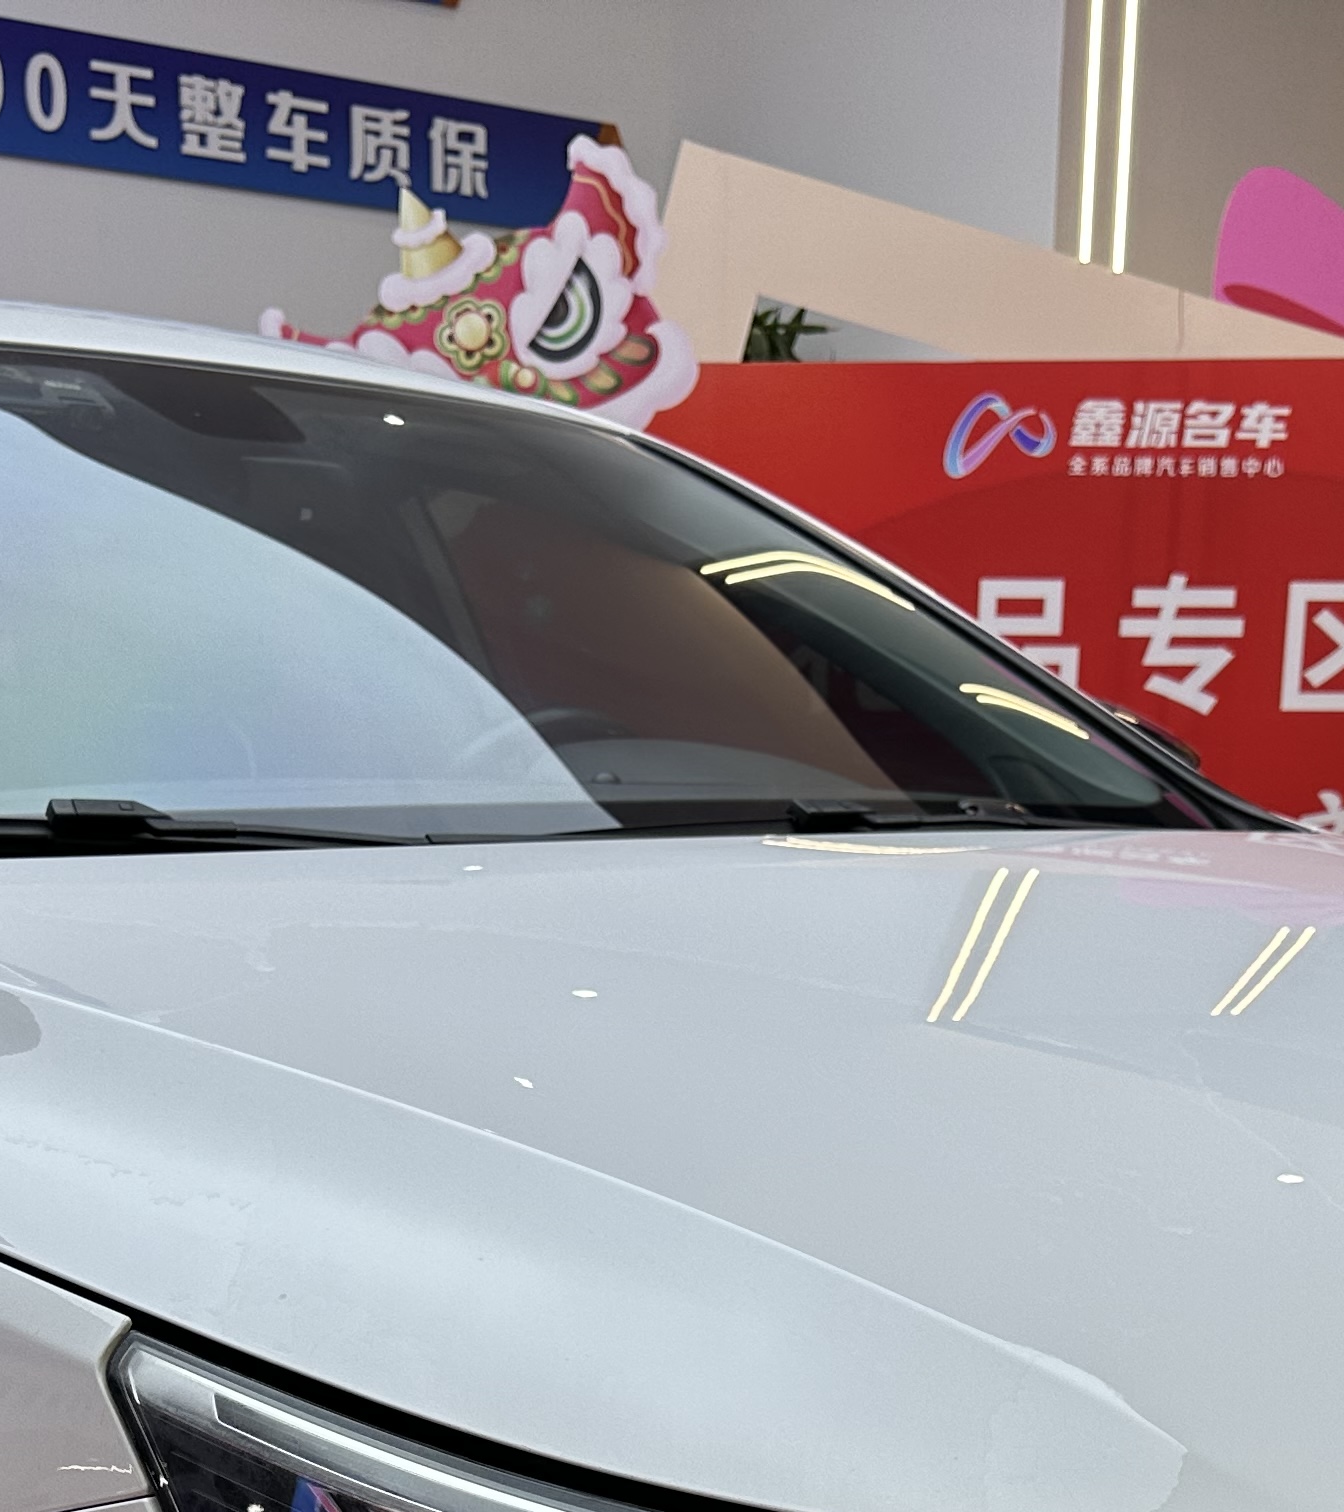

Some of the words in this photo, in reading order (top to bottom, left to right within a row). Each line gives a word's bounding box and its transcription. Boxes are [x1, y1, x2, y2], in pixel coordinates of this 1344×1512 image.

[1067, 398, 1293, 450] 鑫源名车
[1067, 454, 1286, 479] 全系品牌汽车销售中心
